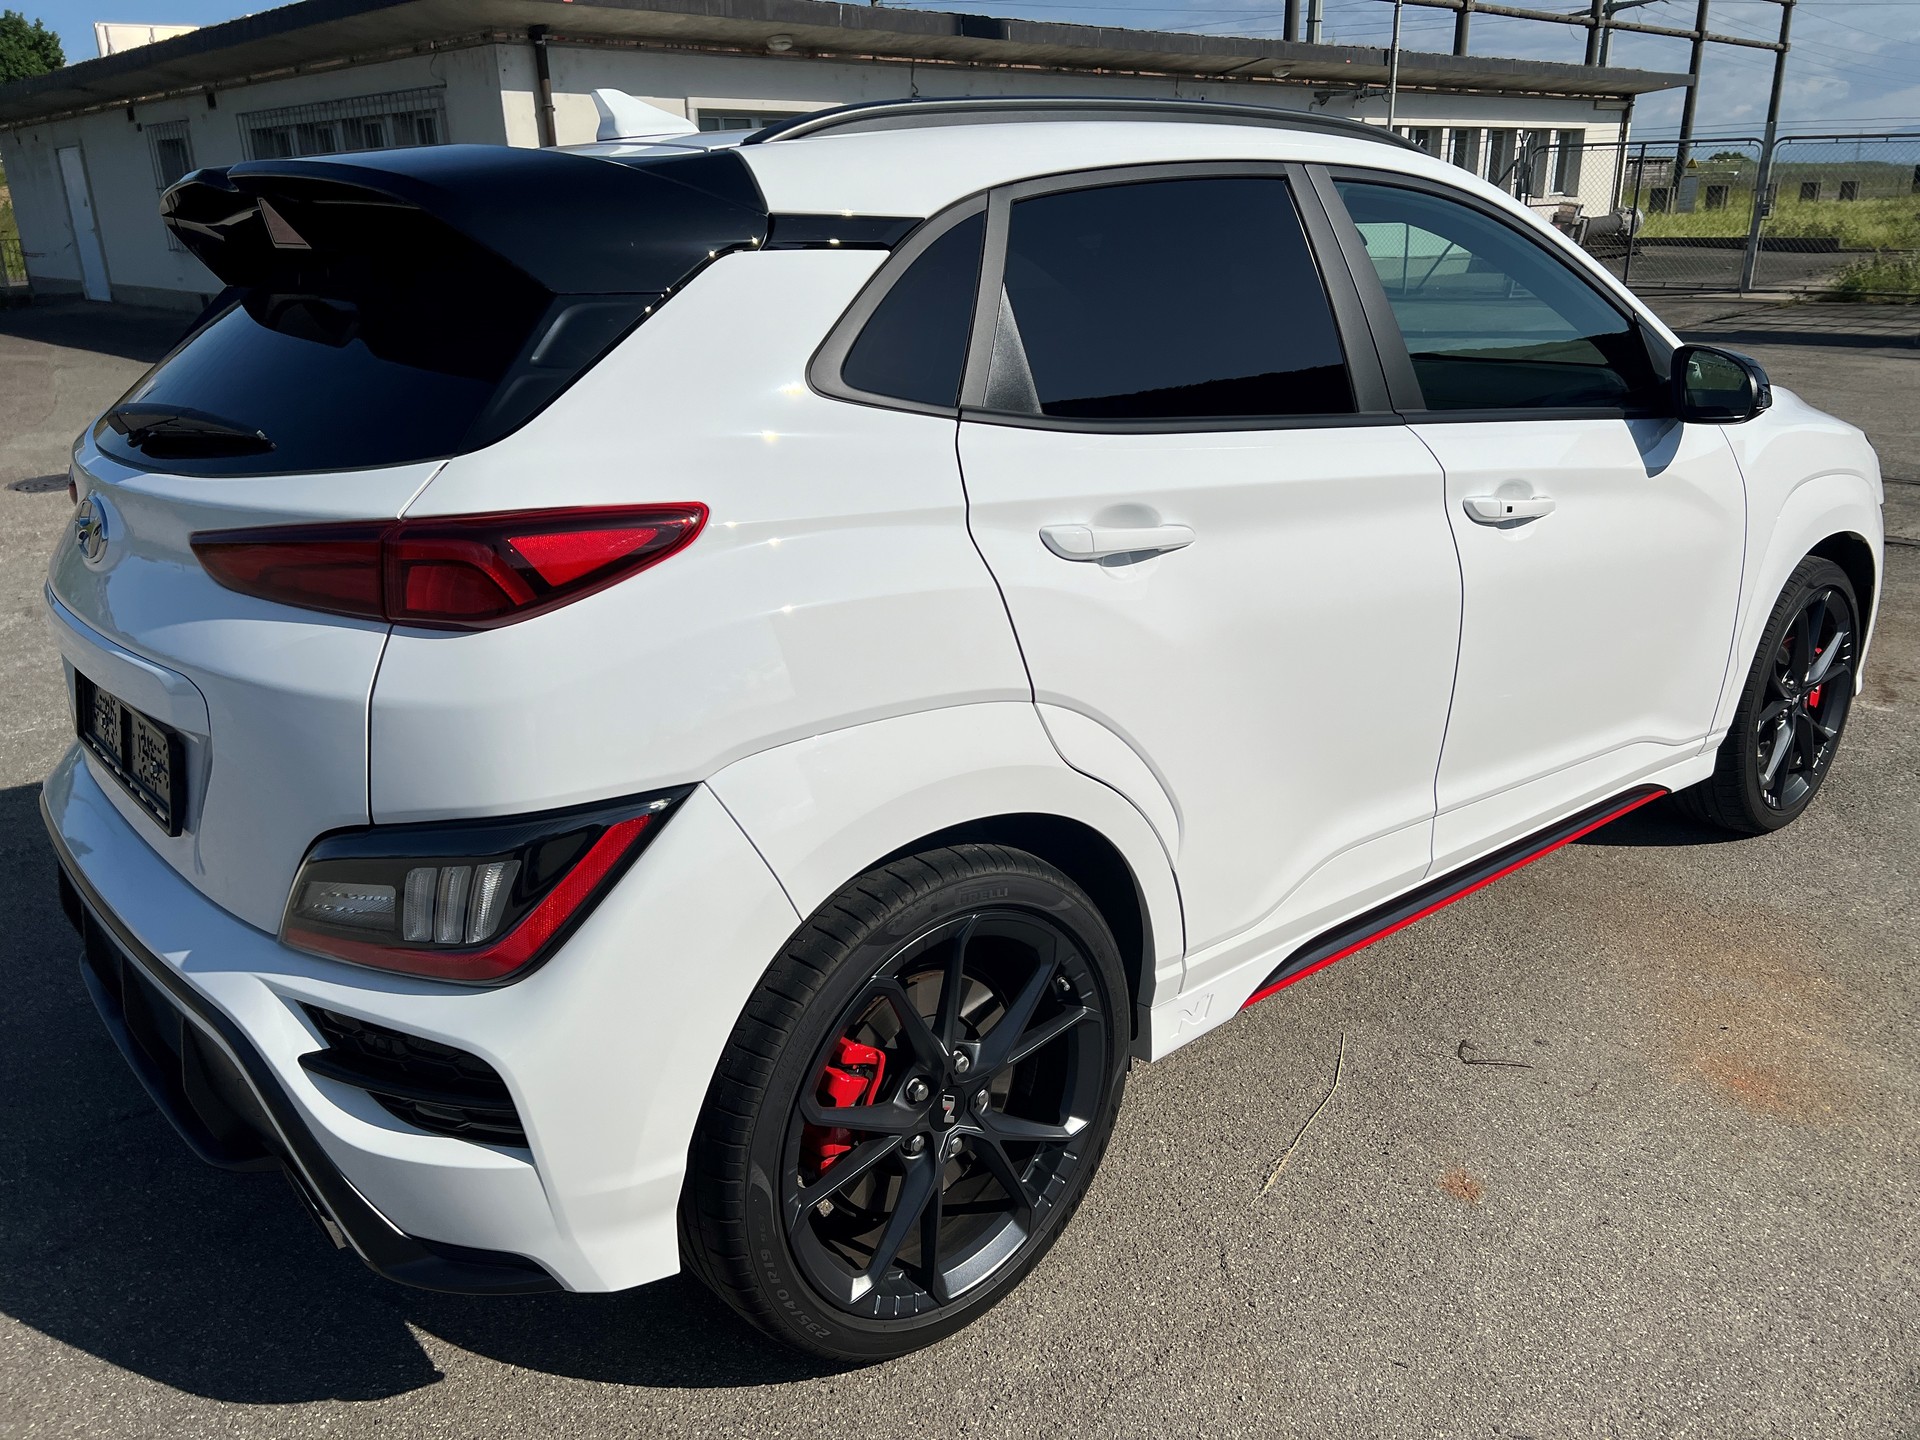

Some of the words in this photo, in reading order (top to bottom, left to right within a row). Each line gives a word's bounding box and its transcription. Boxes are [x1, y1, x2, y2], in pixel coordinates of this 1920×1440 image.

[956, 880, 1008, 906] PIRELLI
[760, 1248, 782, 1284] R19
[775, 1288, 832, 1339] 235/40
